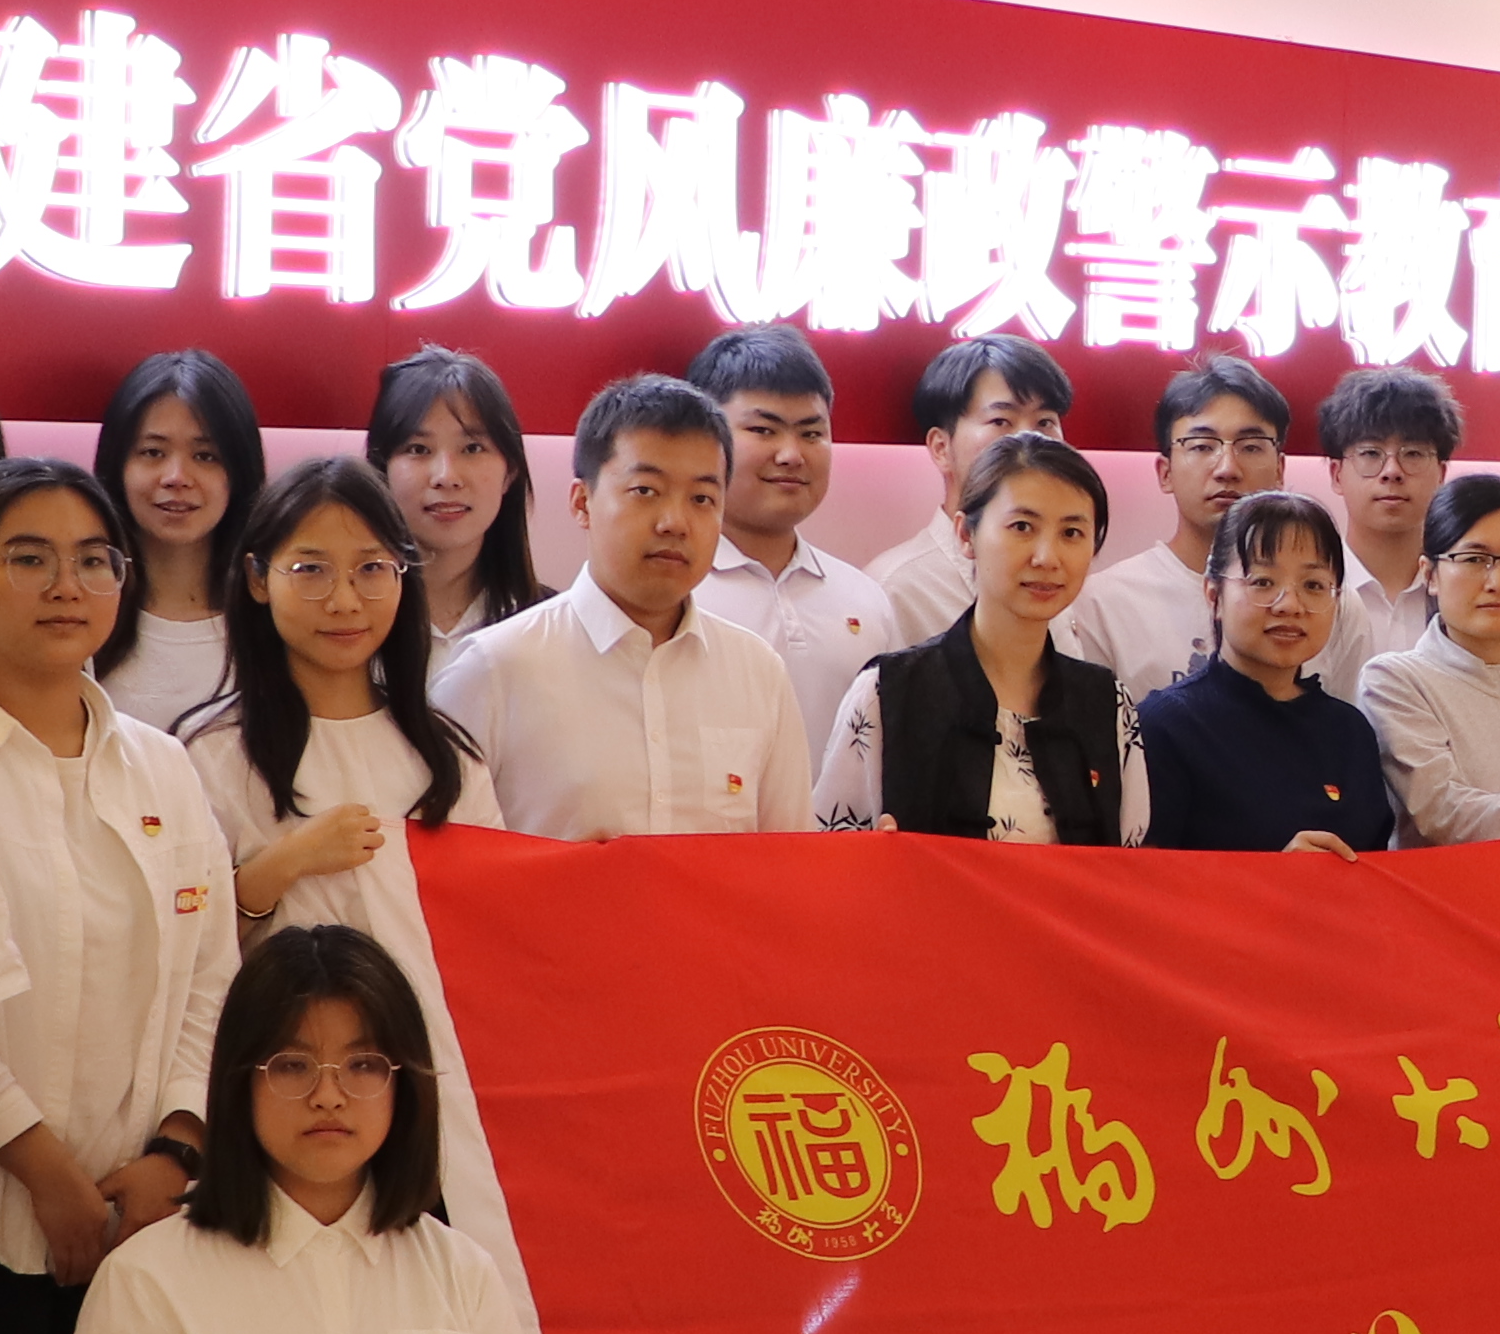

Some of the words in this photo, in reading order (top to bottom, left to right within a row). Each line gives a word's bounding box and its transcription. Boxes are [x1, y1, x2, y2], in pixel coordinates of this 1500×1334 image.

[705, 1044, 756, 1139] FUZHOU
[758, 1035, 907, 1136] UNIVERSITY
[824, 1234, 857, 1249] 1958
